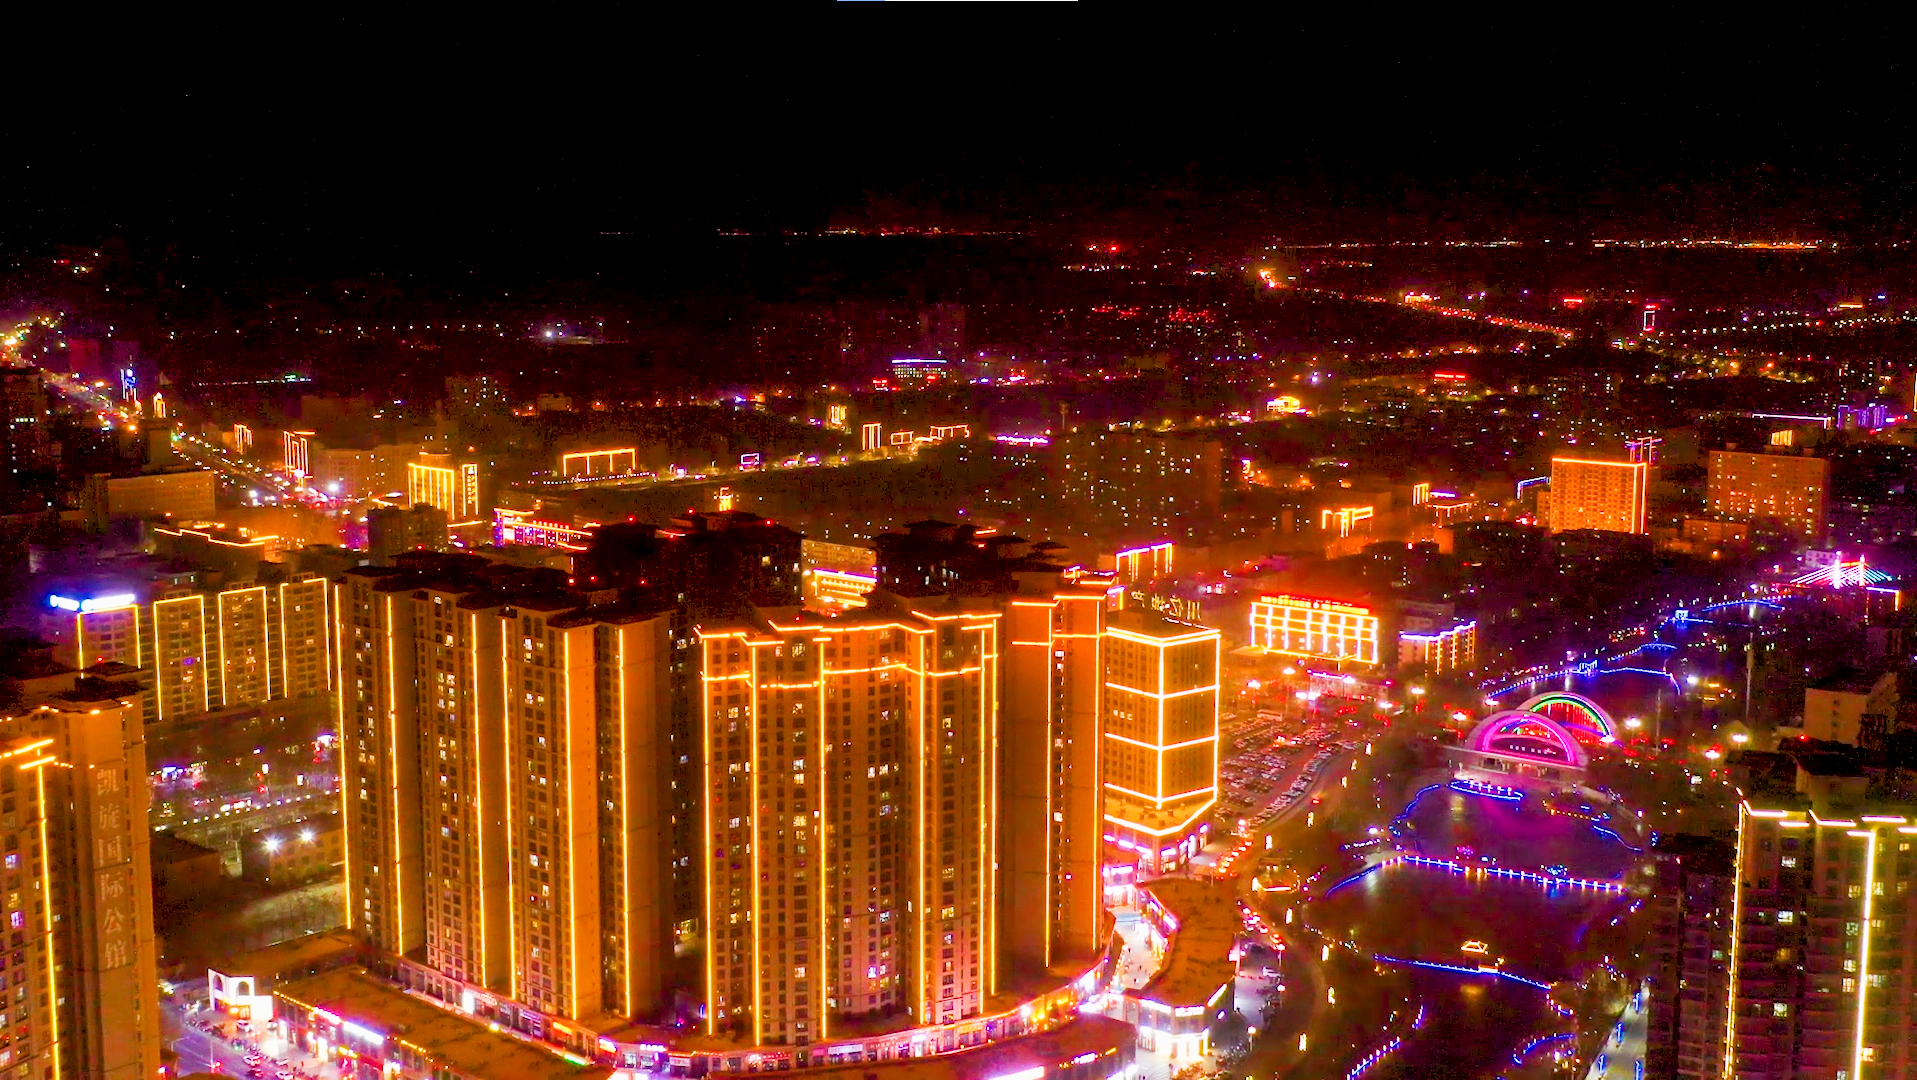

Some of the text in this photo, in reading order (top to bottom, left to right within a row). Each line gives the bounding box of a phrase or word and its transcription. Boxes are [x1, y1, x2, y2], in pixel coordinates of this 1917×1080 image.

[96, 767, 127, 969] 凯旋国际公馆
